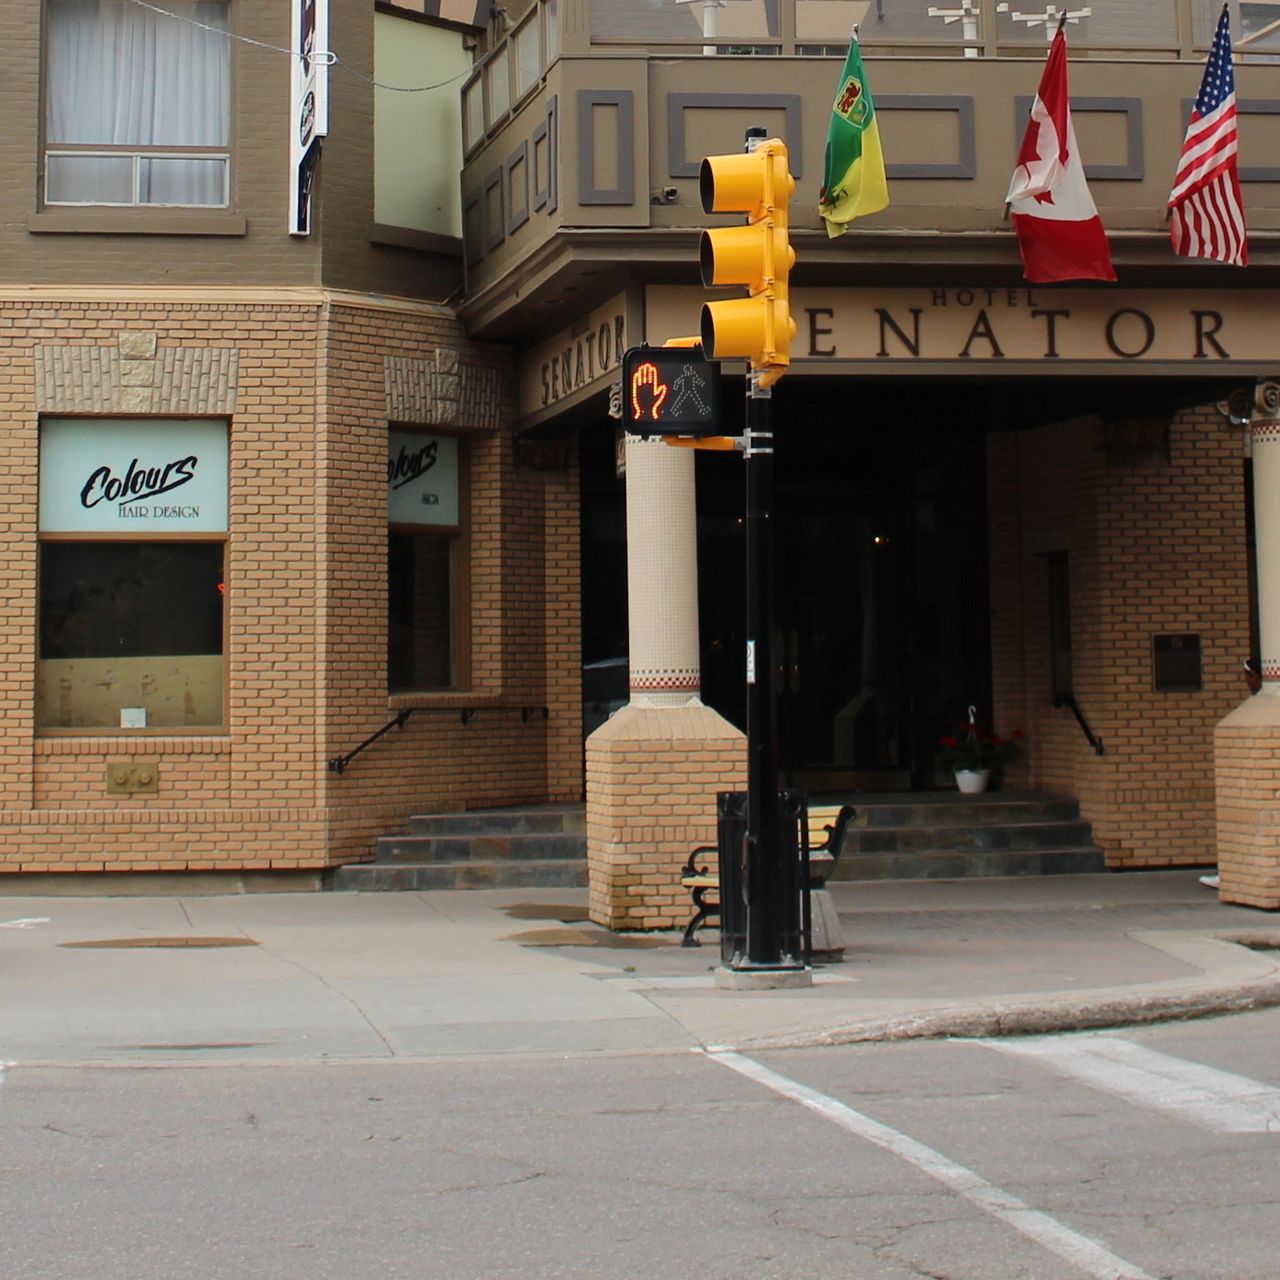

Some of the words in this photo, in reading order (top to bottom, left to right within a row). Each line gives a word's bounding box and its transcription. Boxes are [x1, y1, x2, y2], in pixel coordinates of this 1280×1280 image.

[931, 289, 1038, 307] HOTEL
[803, 308, 1230, 359] ENATOR
[541, 314, 625, 406] SENATOR
[80, 455, 197, 509] Colours
[118, 506, 149, 518] HAIR
[153, 506, 200, 518] DESIGN
